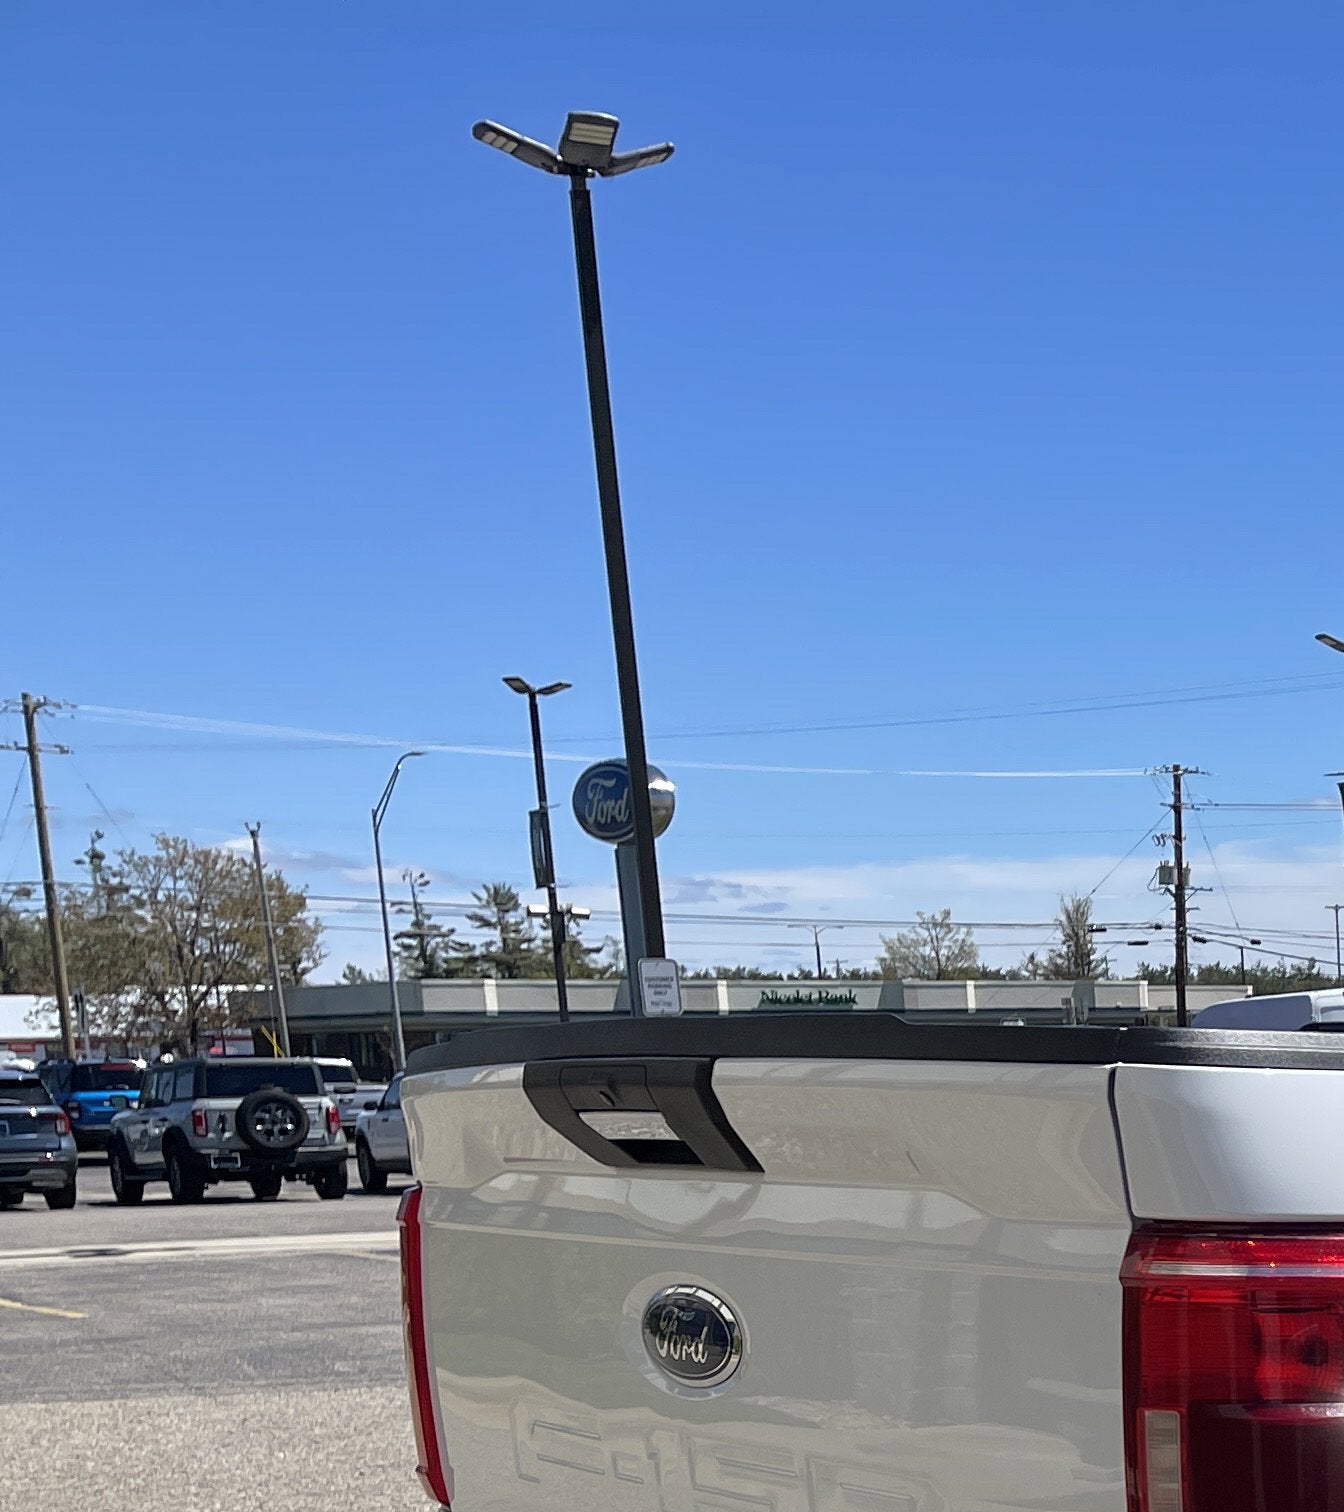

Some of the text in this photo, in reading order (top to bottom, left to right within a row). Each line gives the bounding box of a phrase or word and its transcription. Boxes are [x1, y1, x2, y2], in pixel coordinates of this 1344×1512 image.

[585, 777, 630, 824] Ford
[818, 988, 858, 1005] Bank
[655, 1304, 710, 1366] Ford
